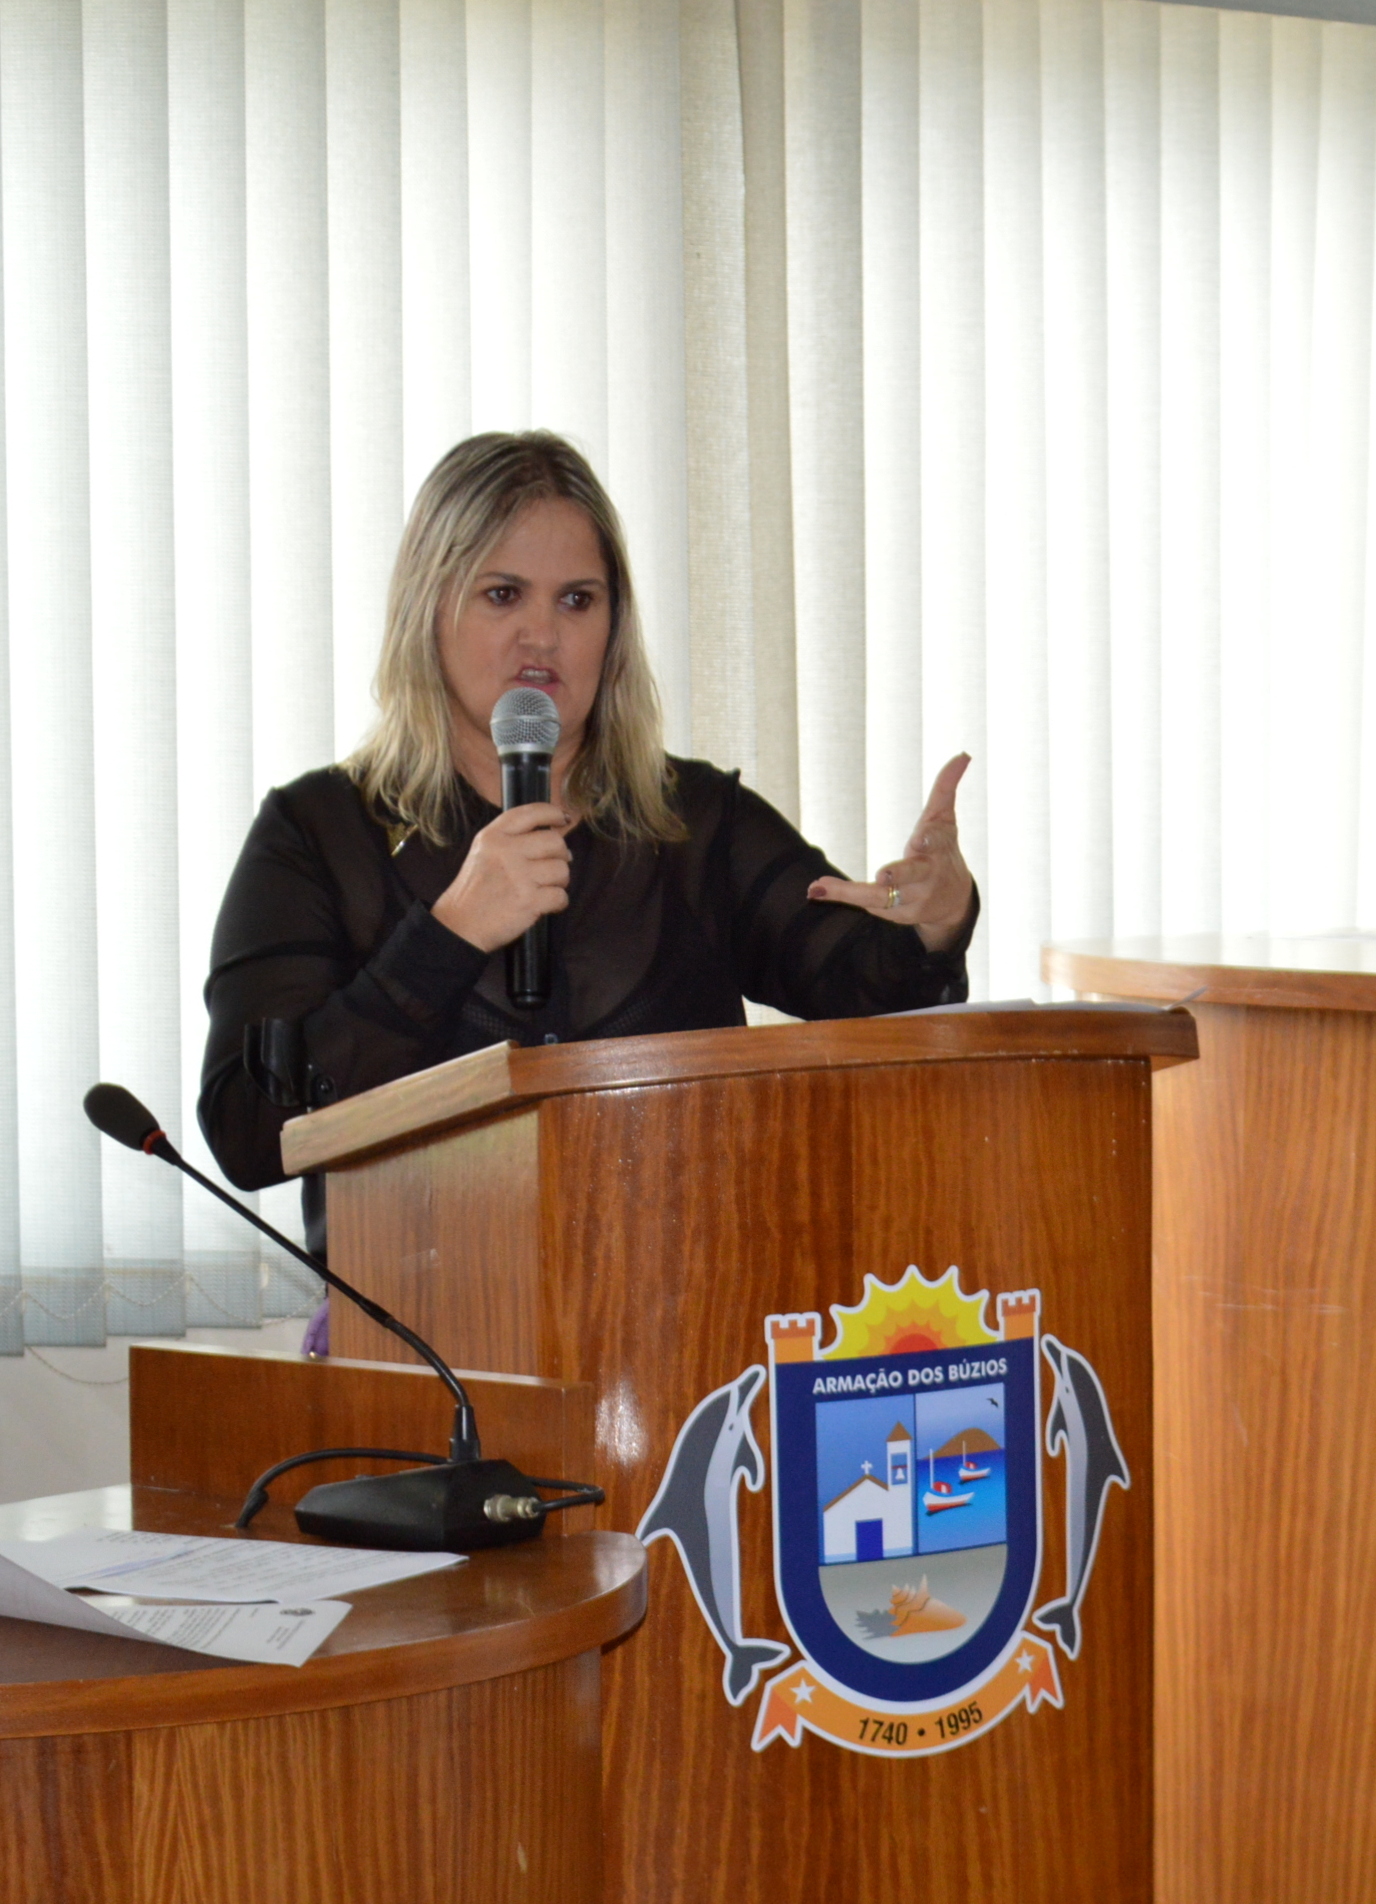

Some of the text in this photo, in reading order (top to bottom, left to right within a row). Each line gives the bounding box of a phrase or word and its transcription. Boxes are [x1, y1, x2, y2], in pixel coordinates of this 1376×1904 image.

[812, 1358, 1008, 1395] ARMAÇÃO DOS BÚZIOS
[858, 1701, 984, 1746] 1740 1995
